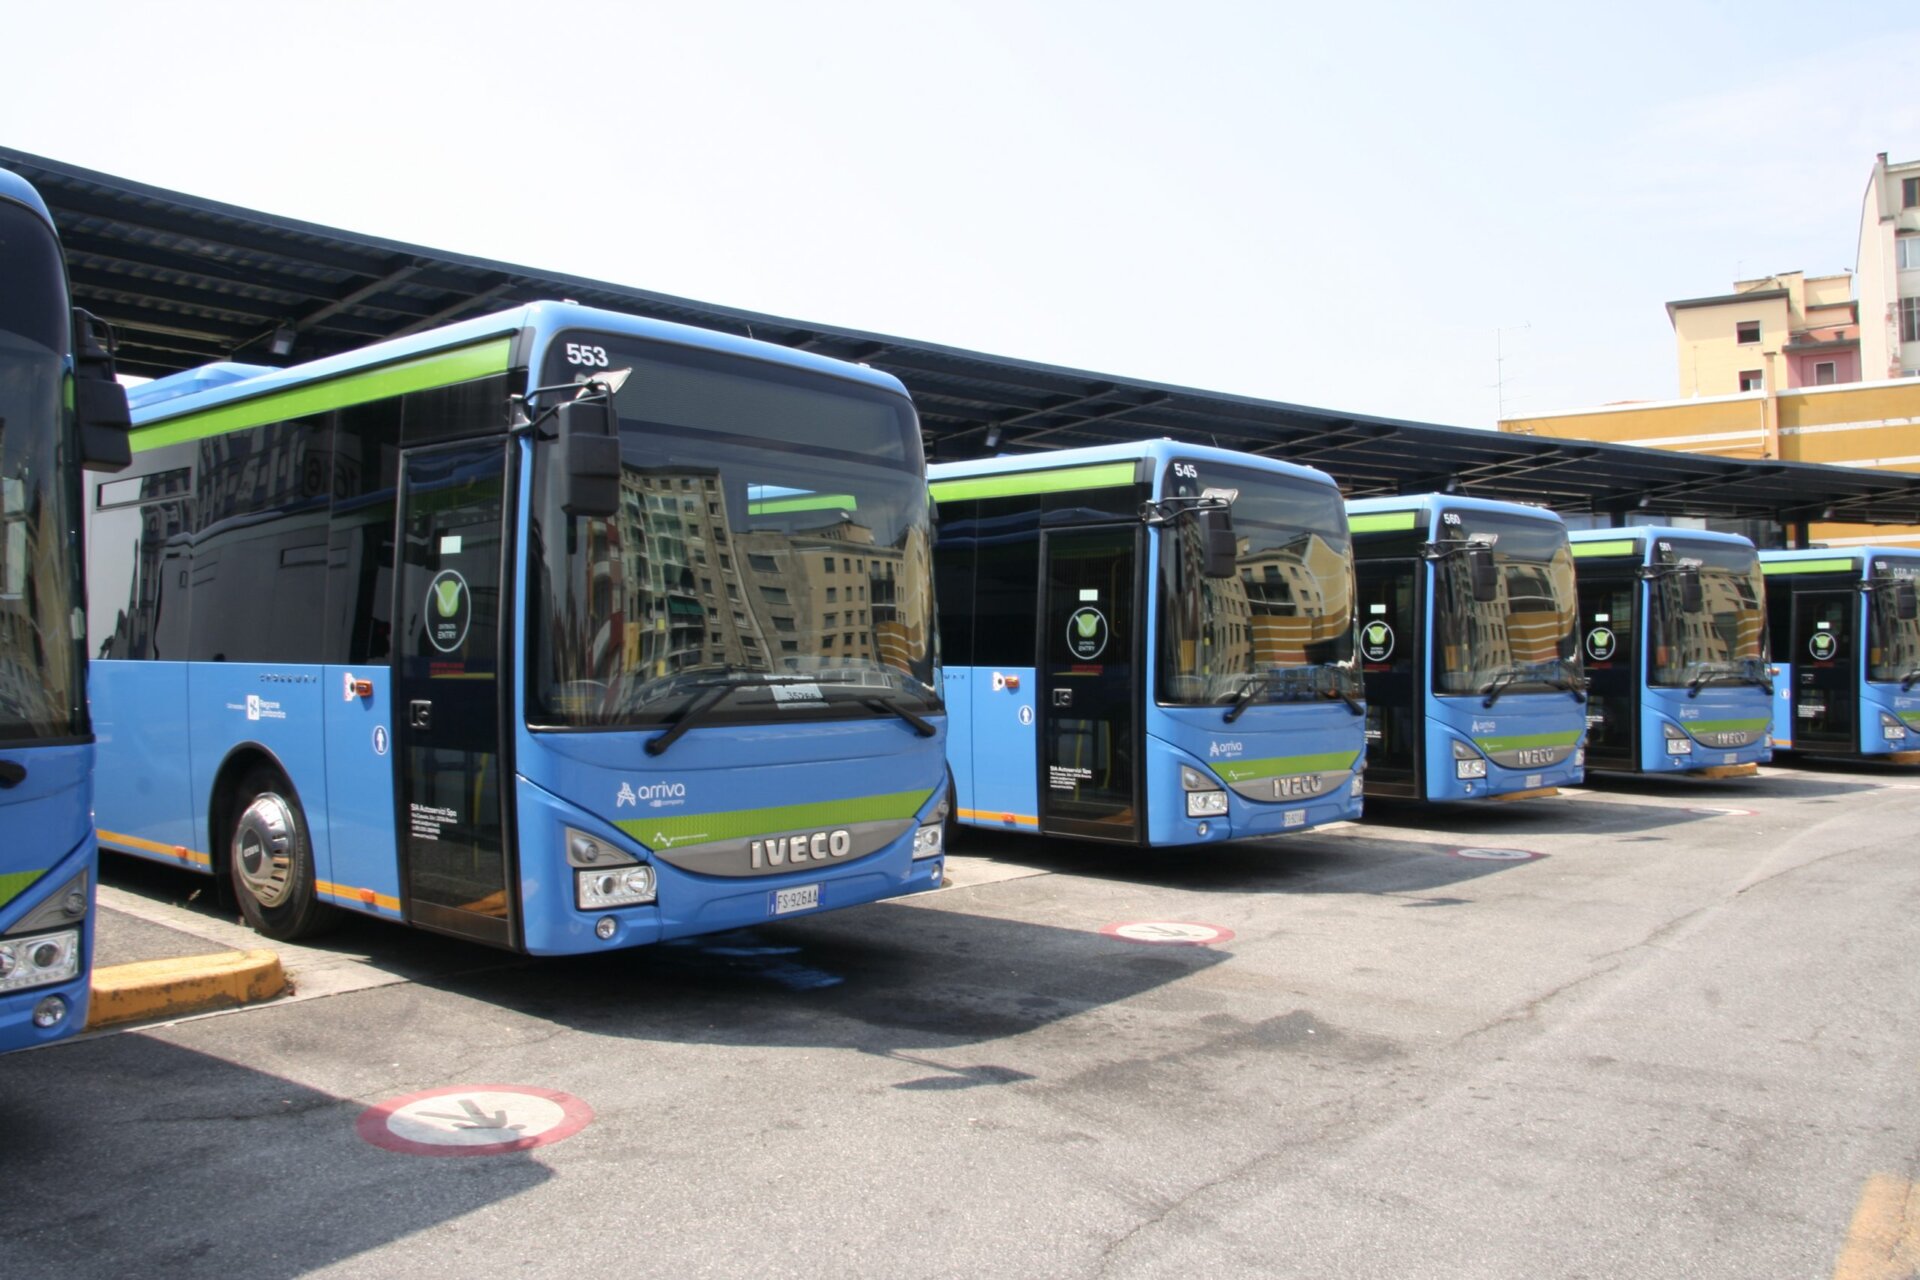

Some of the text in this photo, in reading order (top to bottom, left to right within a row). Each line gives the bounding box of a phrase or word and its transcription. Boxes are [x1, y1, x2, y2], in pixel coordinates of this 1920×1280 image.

[566, 342, 609, 367] 553
[1173, 462, 1197, 478] 545
[438, 631, 457, 639] ENTRY
[1518, 748, 1554, 765] IVECO
[638, 781, 685, 799] arriva
[1272, 776, 1322, 797] IVECO
[751, 830, 850, 869] IVECO
